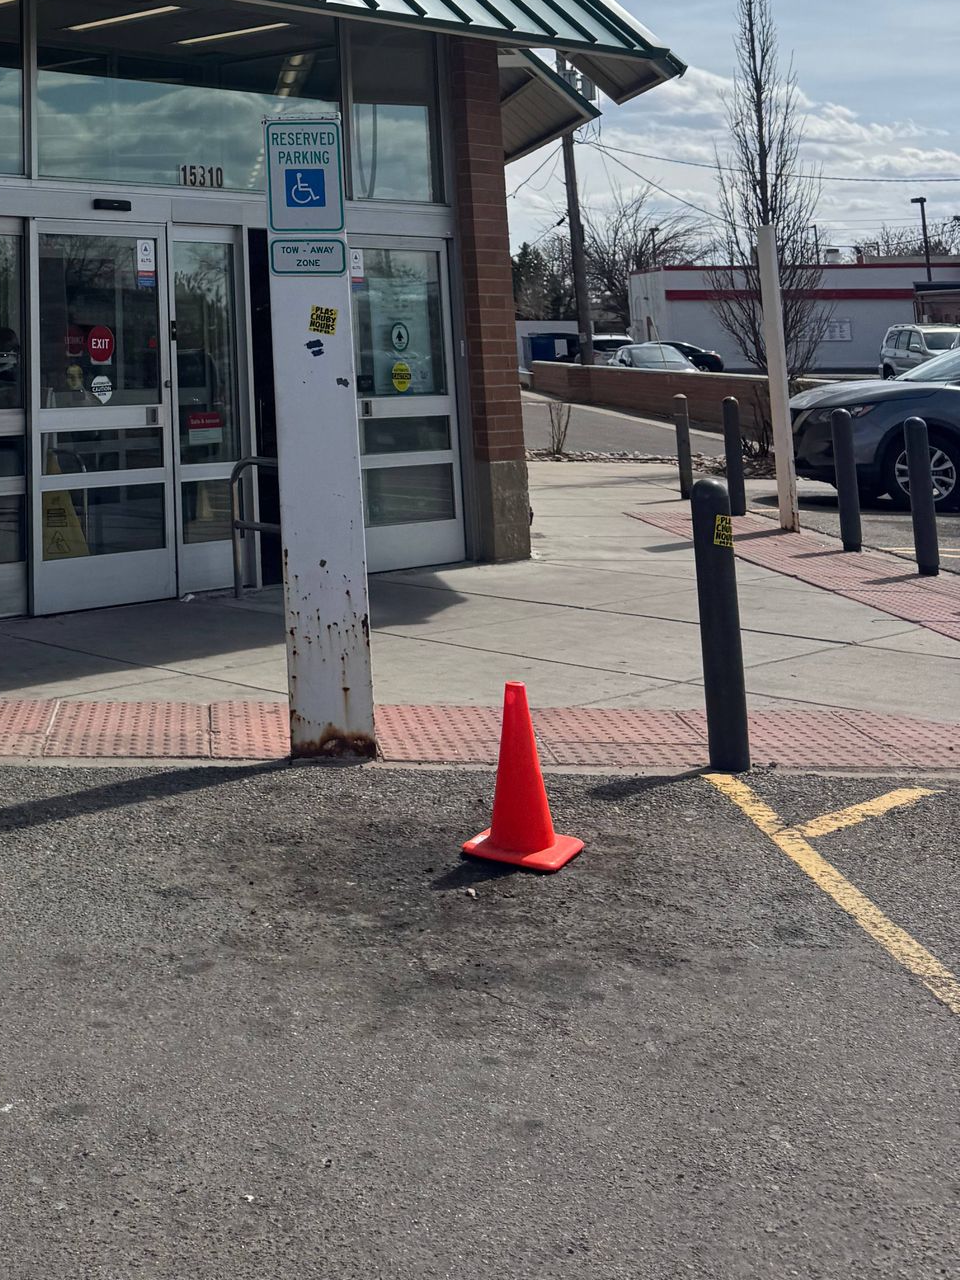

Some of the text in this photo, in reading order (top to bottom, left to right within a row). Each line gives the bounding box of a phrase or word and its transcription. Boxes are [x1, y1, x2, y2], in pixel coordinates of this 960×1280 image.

[271, 132, 335, 146] RESERVED
[278, 151, 330, 165] PARKING
[181, 165, 223, 188] 15310
[281, 246, 299, 254] TOW
[310, 246, 334, 254] AWAY
[296, 259, 320, 267] ZONE
[91, 338, 110, 349] EXIT
